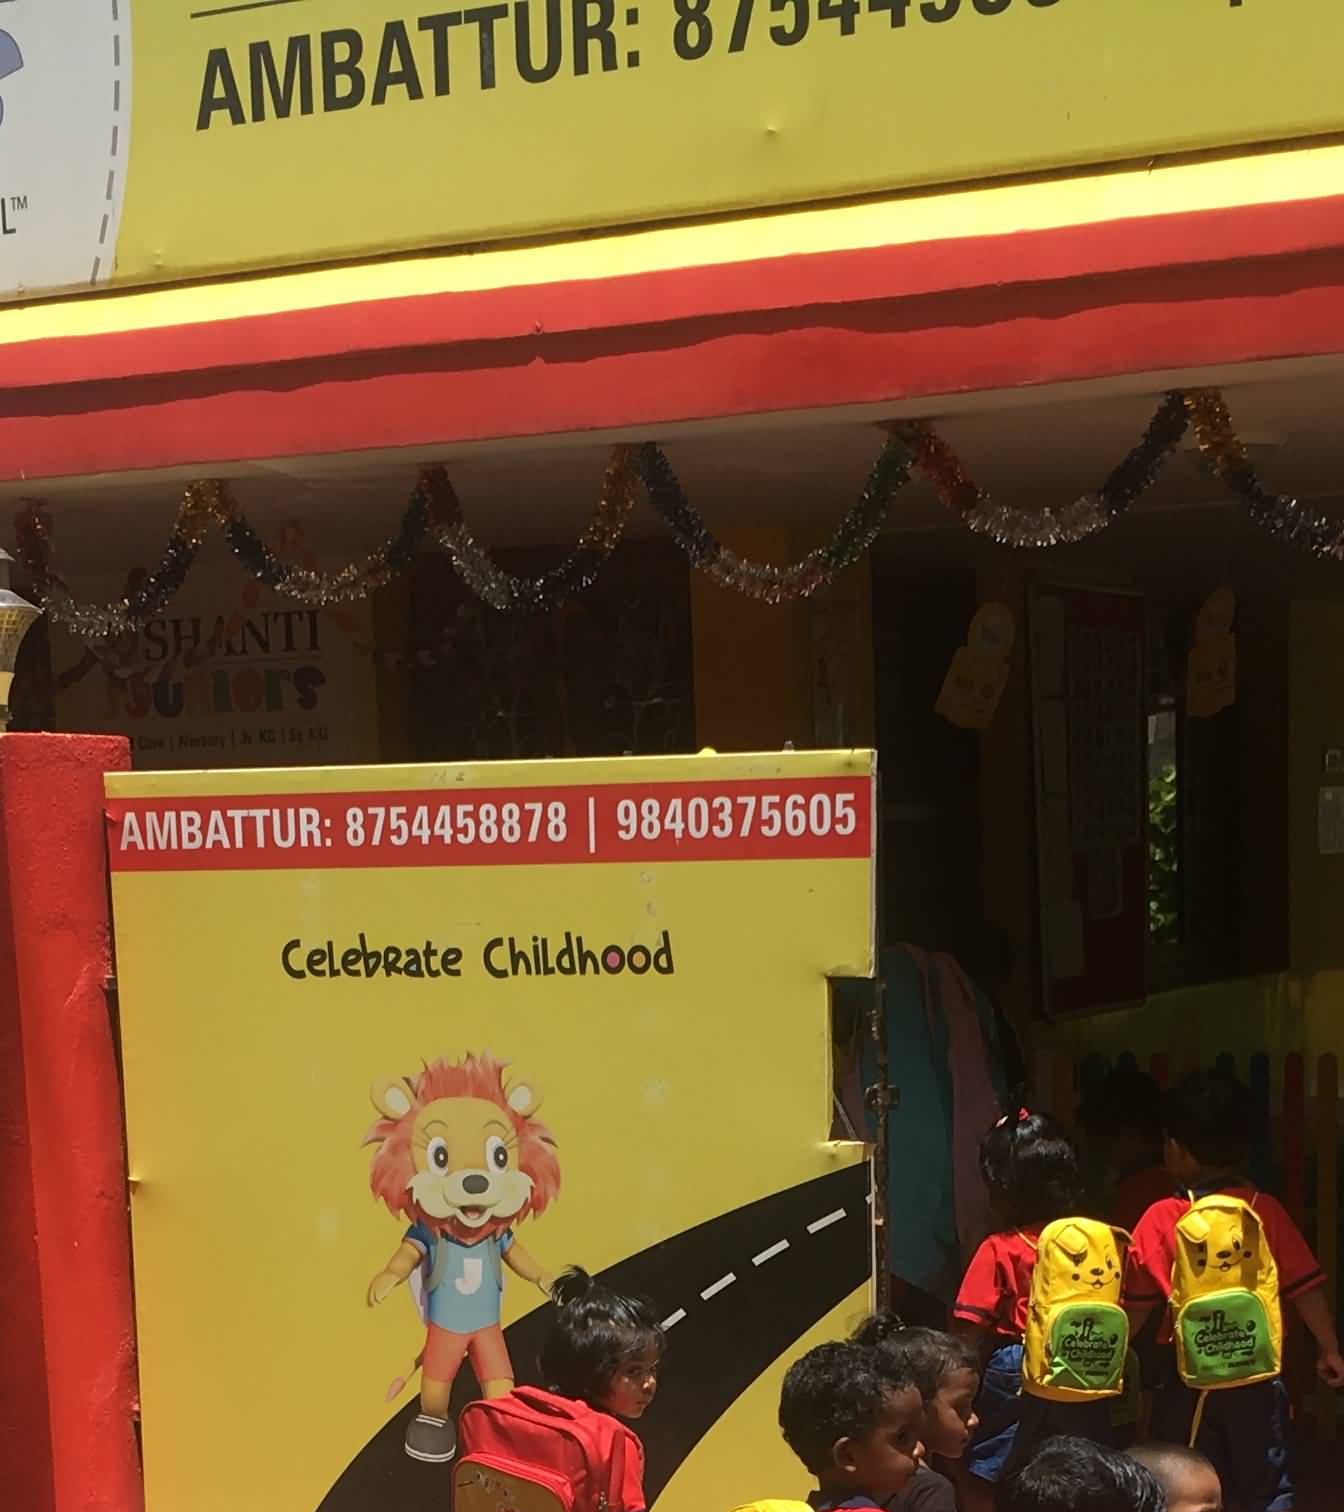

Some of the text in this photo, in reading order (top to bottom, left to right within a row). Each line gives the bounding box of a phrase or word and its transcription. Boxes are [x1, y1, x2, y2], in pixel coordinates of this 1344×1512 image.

[196, 0, 640, 131] AMBATTUR:
[145, 609, 322, 661] SHANTI
[119, 807, 333, 852] AMBATTUR:
[346, 801, 567, 847] 8754458878
[616, 793, 857, 841] 9840375605
[483, 930, 675, 980] Childhood
